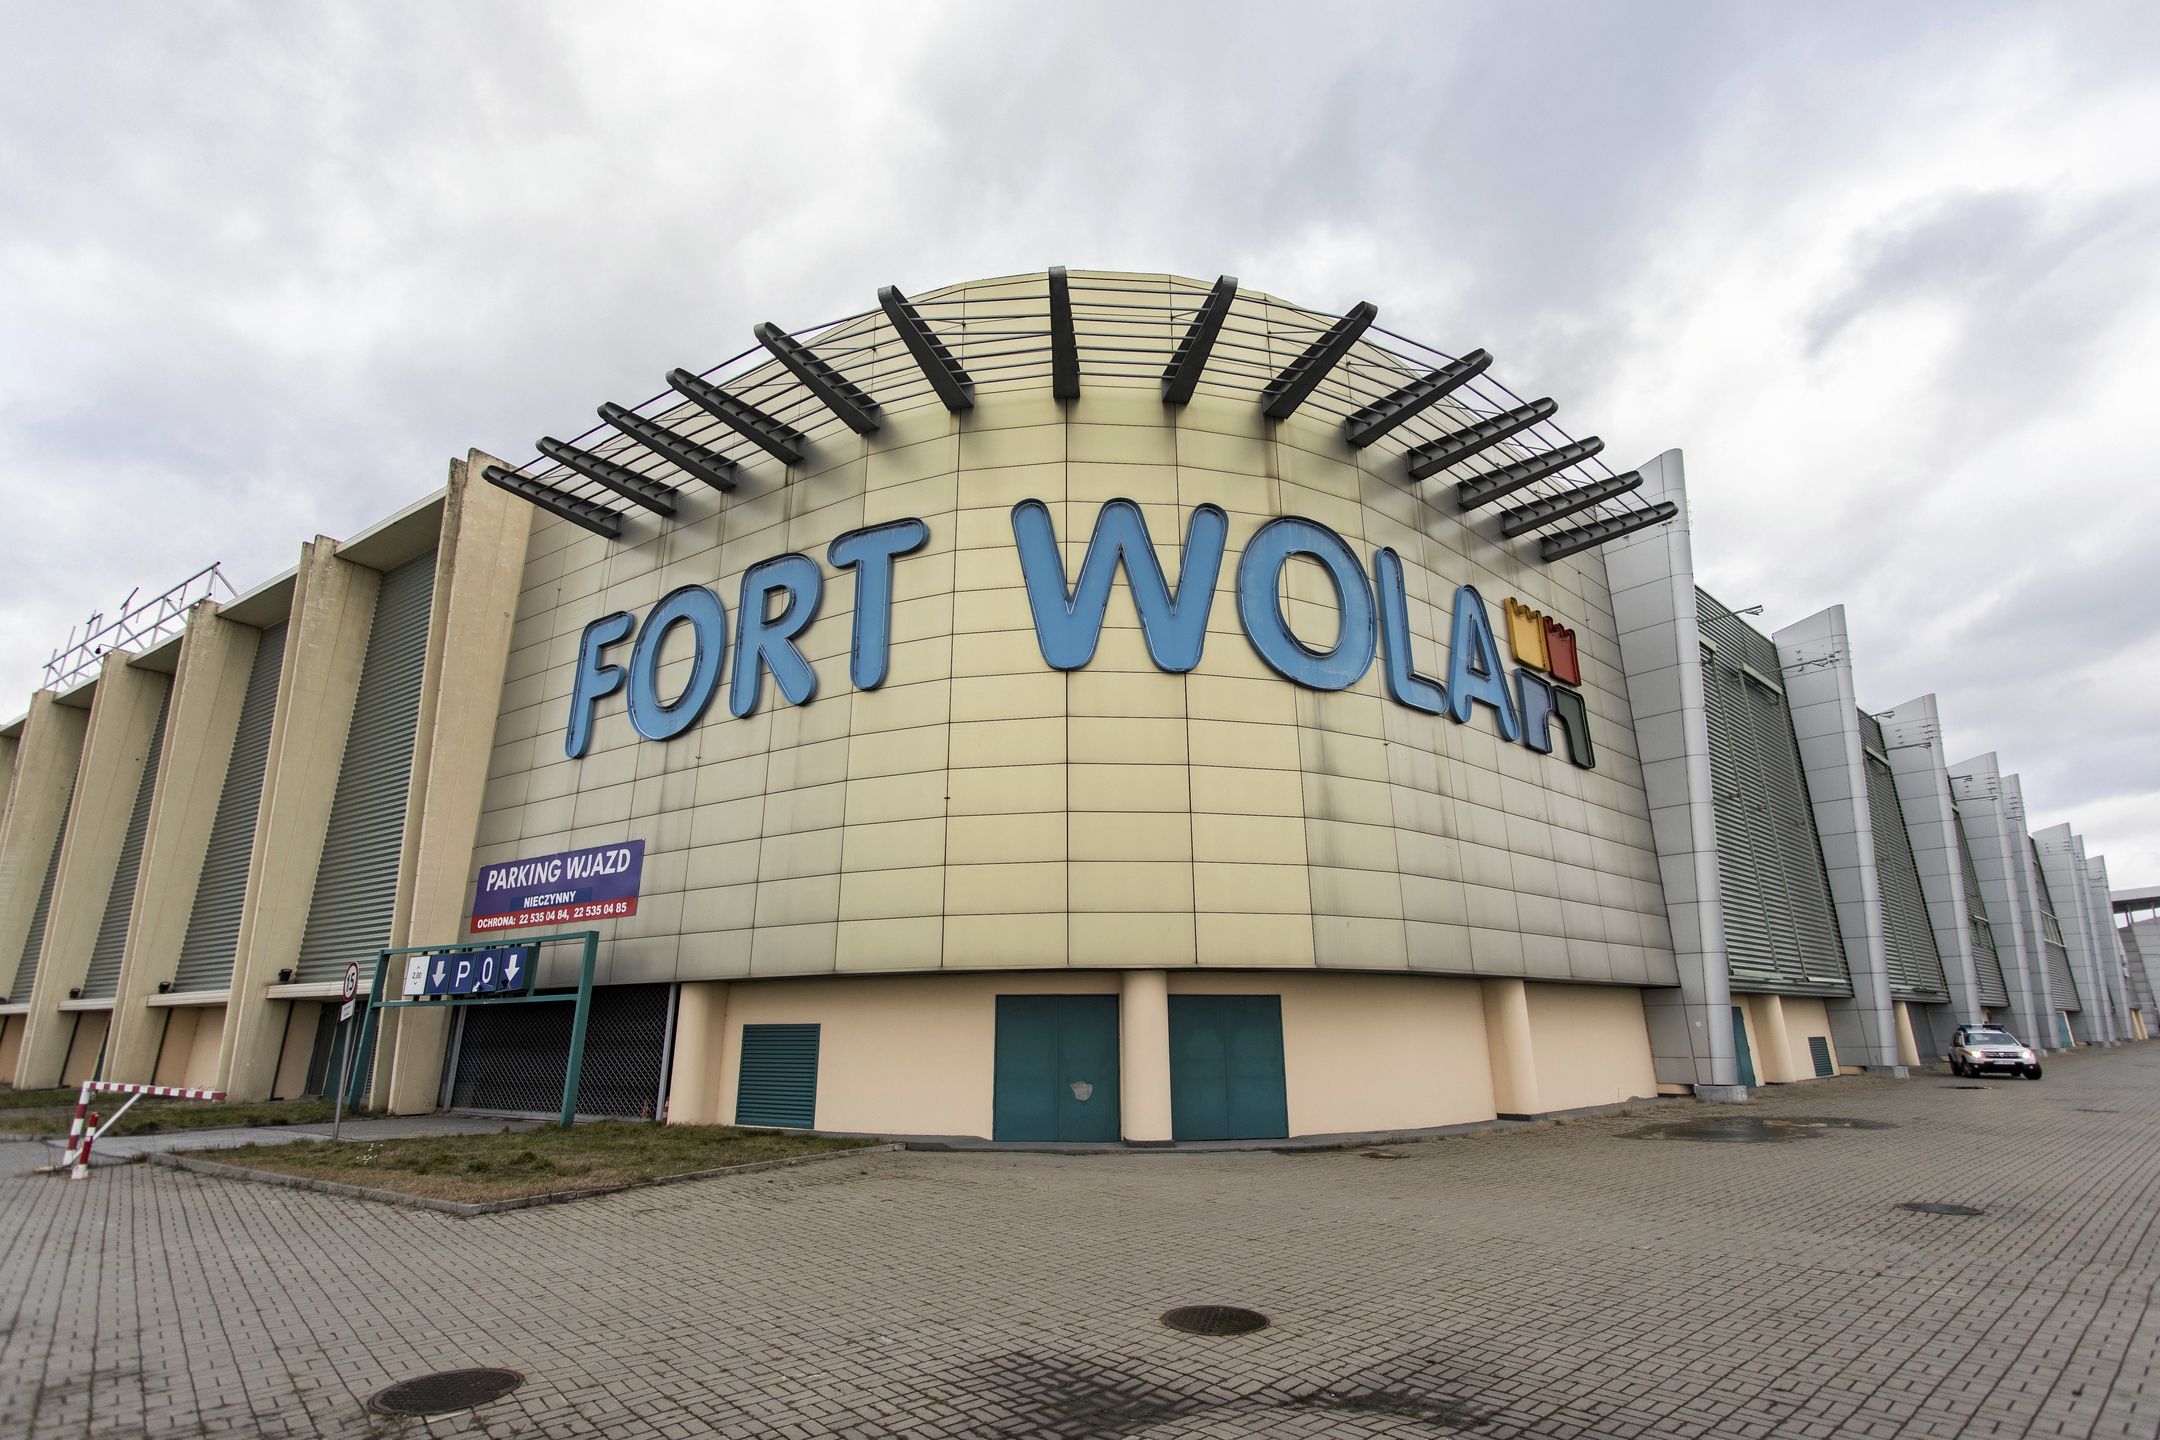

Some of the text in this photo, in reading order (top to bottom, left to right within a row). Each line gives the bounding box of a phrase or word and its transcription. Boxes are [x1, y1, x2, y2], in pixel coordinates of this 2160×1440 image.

[565, 498, 1520, 759] FORT WOLA
[486, 848, 631, 892] PARKING WJAZD
[523, 891, 577, 909] NIECZYNNY
[477, 901, 627, 929] OCHRONA: 22 535 04 84, 22 535 04 85
[346, 972, 356, 993] 15
[456, 962, 471, 988] P
